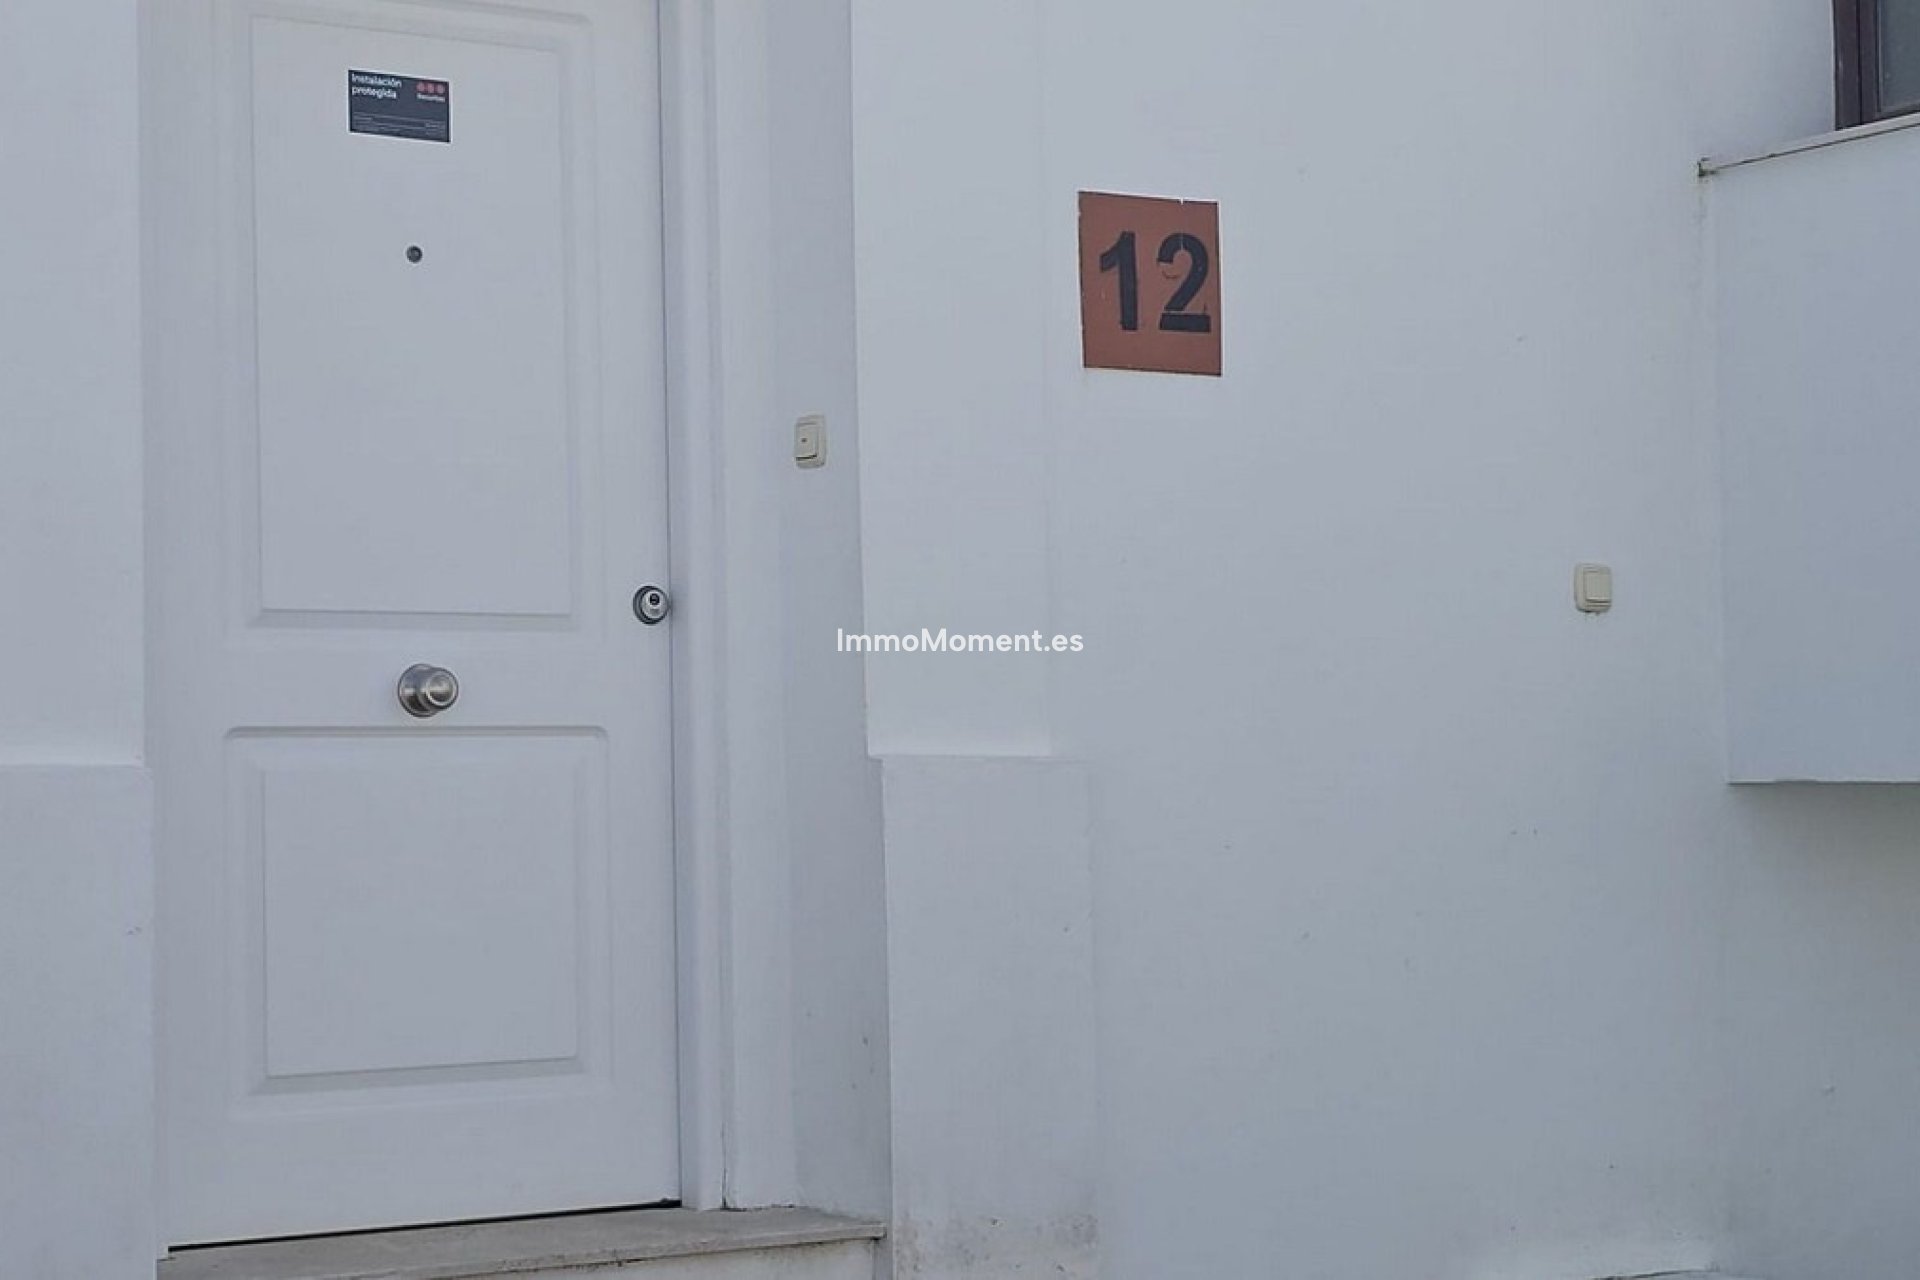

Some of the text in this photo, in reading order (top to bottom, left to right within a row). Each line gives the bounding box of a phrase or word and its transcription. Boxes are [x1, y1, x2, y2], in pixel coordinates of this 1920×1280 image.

[351, 73, 402, 88] Instalación
[351, 86, 397, 99] protegida
[1099, 231, 1212, 333] 12
